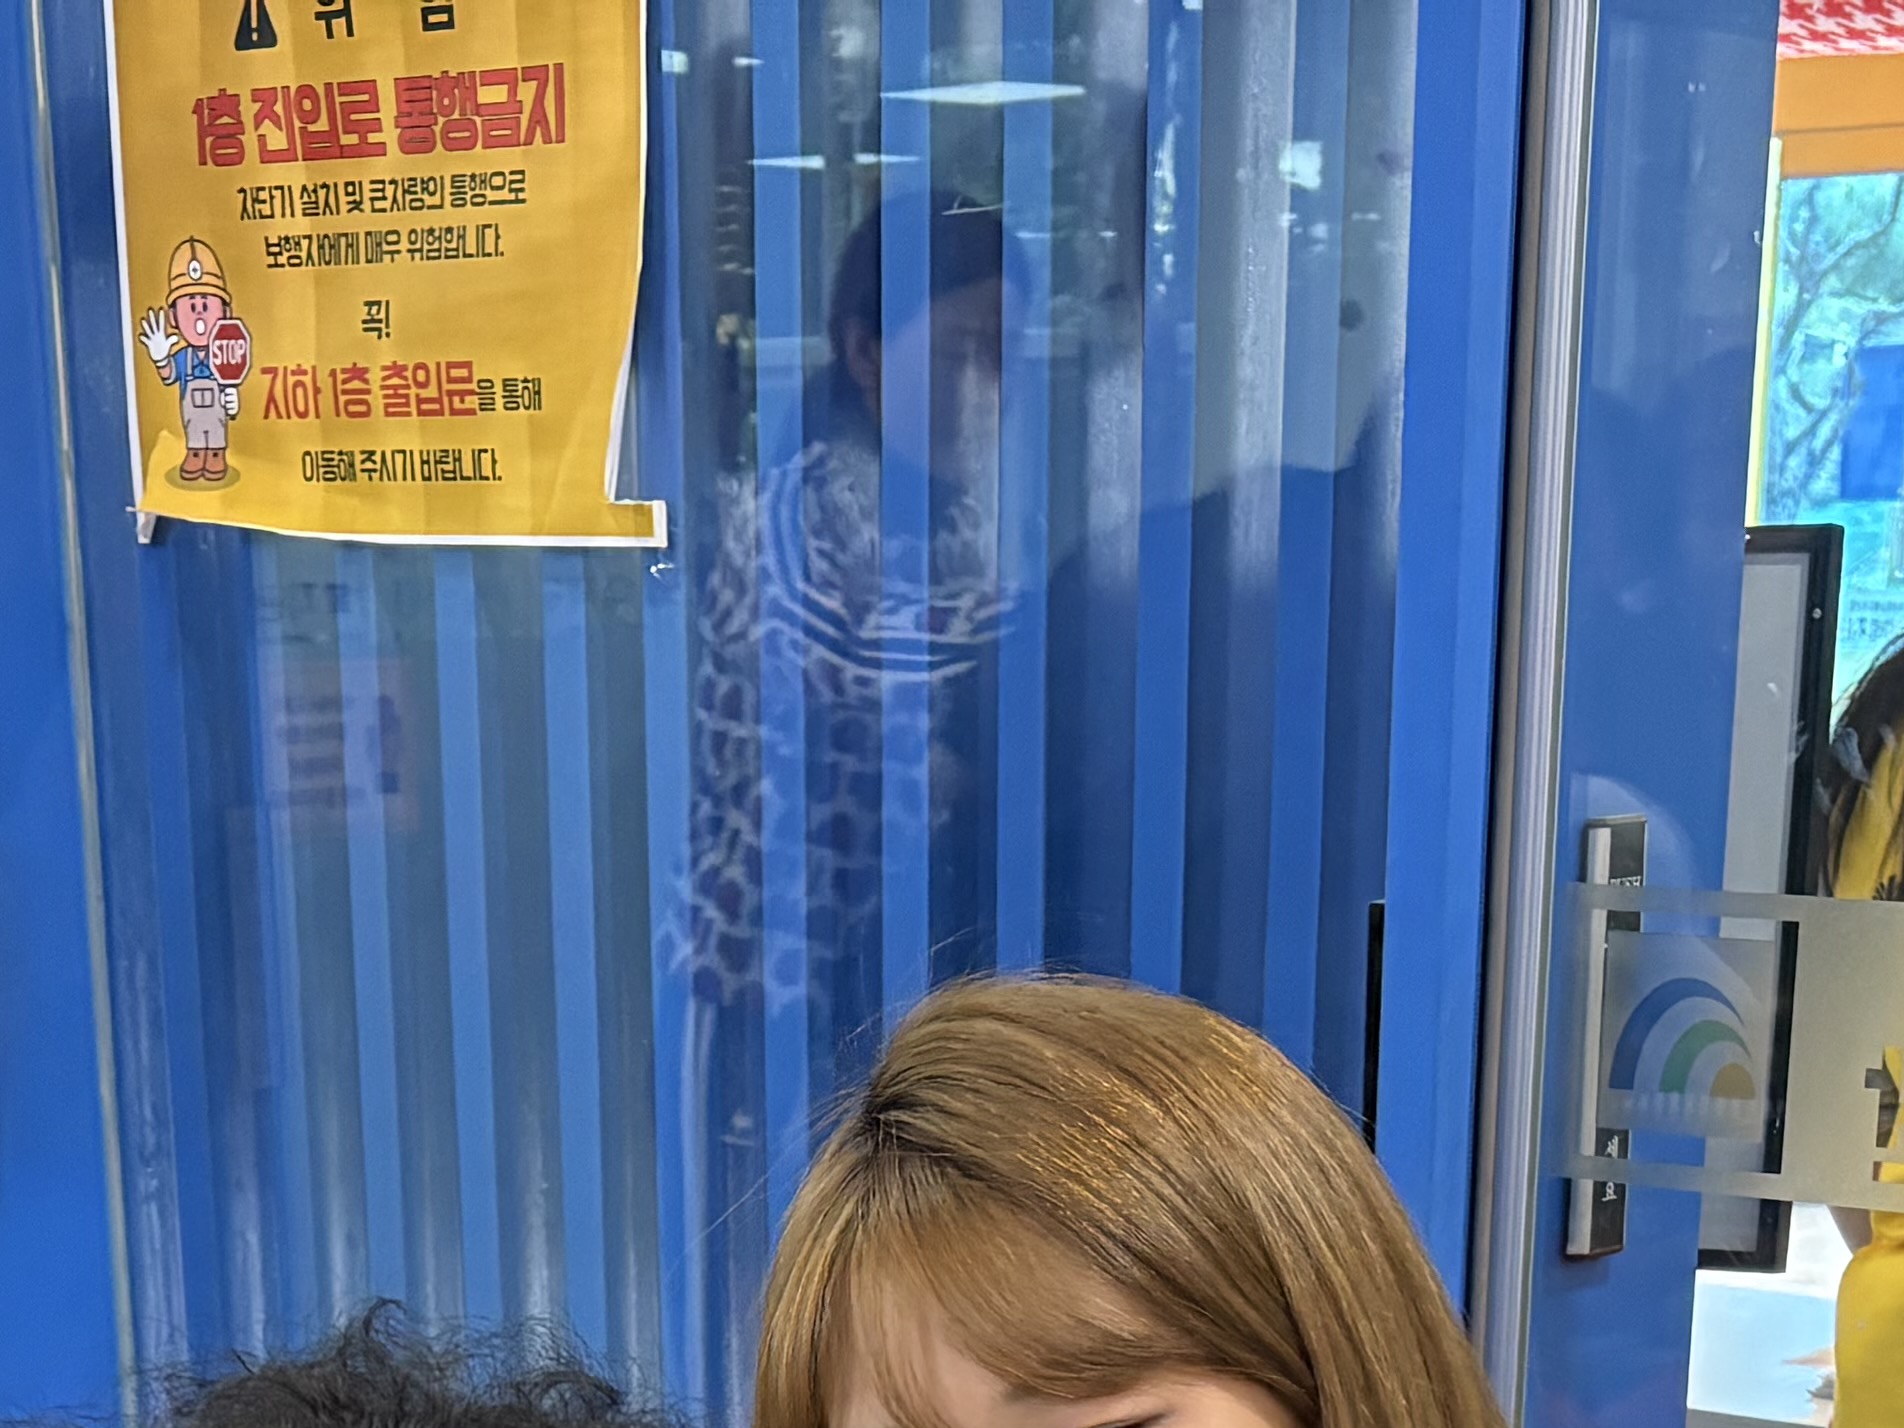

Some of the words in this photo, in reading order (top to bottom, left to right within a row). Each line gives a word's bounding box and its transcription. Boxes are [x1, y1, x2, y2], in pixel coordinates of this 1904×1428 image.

[192, 88, 246, 167] 1층
[250, 80, 388, 165] 진입로
[394, 63, 566, 155] 통행금지
[237, 182, 296, 221] 차단기
[299, 181, 340, 218] 설치
[344, 180, 364, 214] 및
[368, 175, 446, 212] 큰차량의
[449, 170, 528, 207] 통행으로
[264, 233, 361, 269] 보행자에게
[364, 229, 403, 265] 매우
[406, 223, 505, 263] 위험합니다.
[361, 299, 392, 340] 꼭!
[212, 338, 246, 366] STOP
[260, 365, 321, 420] 지하
[328, 364, 372, 419] 1층
[379, 360, 496, 419] 출입문을
[501, 377, 542, 411] 통해
[302, 449, 356, 482] 이동해
[359, 449, 415, 482] 주시기
[419, 447, 503, 482] 바랍니다.
